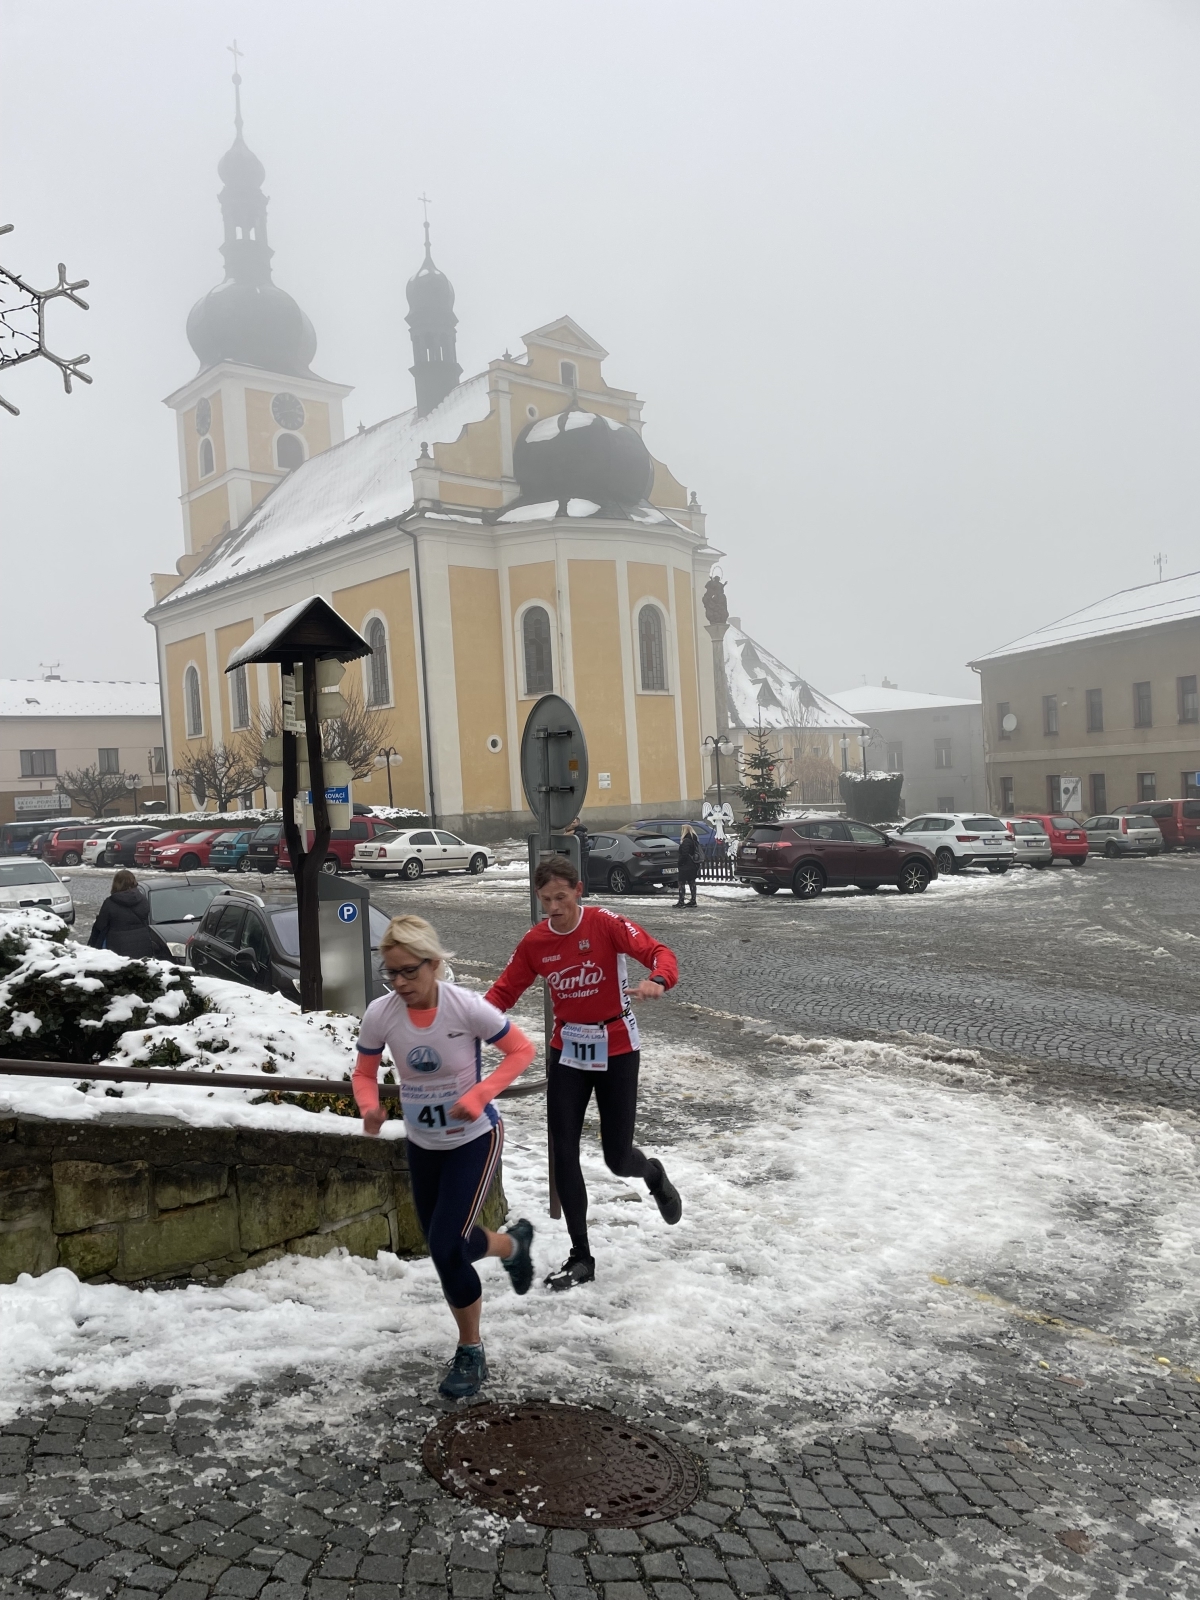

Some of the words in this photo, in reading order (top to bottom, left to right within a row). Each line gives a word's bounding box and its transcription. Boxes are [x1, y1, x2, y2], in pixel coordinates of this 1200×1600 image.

[547, 966, 603, 990] Carla
[557, 988, 599, 999] Chocolates
[571, 1041, 595, 1060] 111
[417, 1104, 447, 1128] 41
